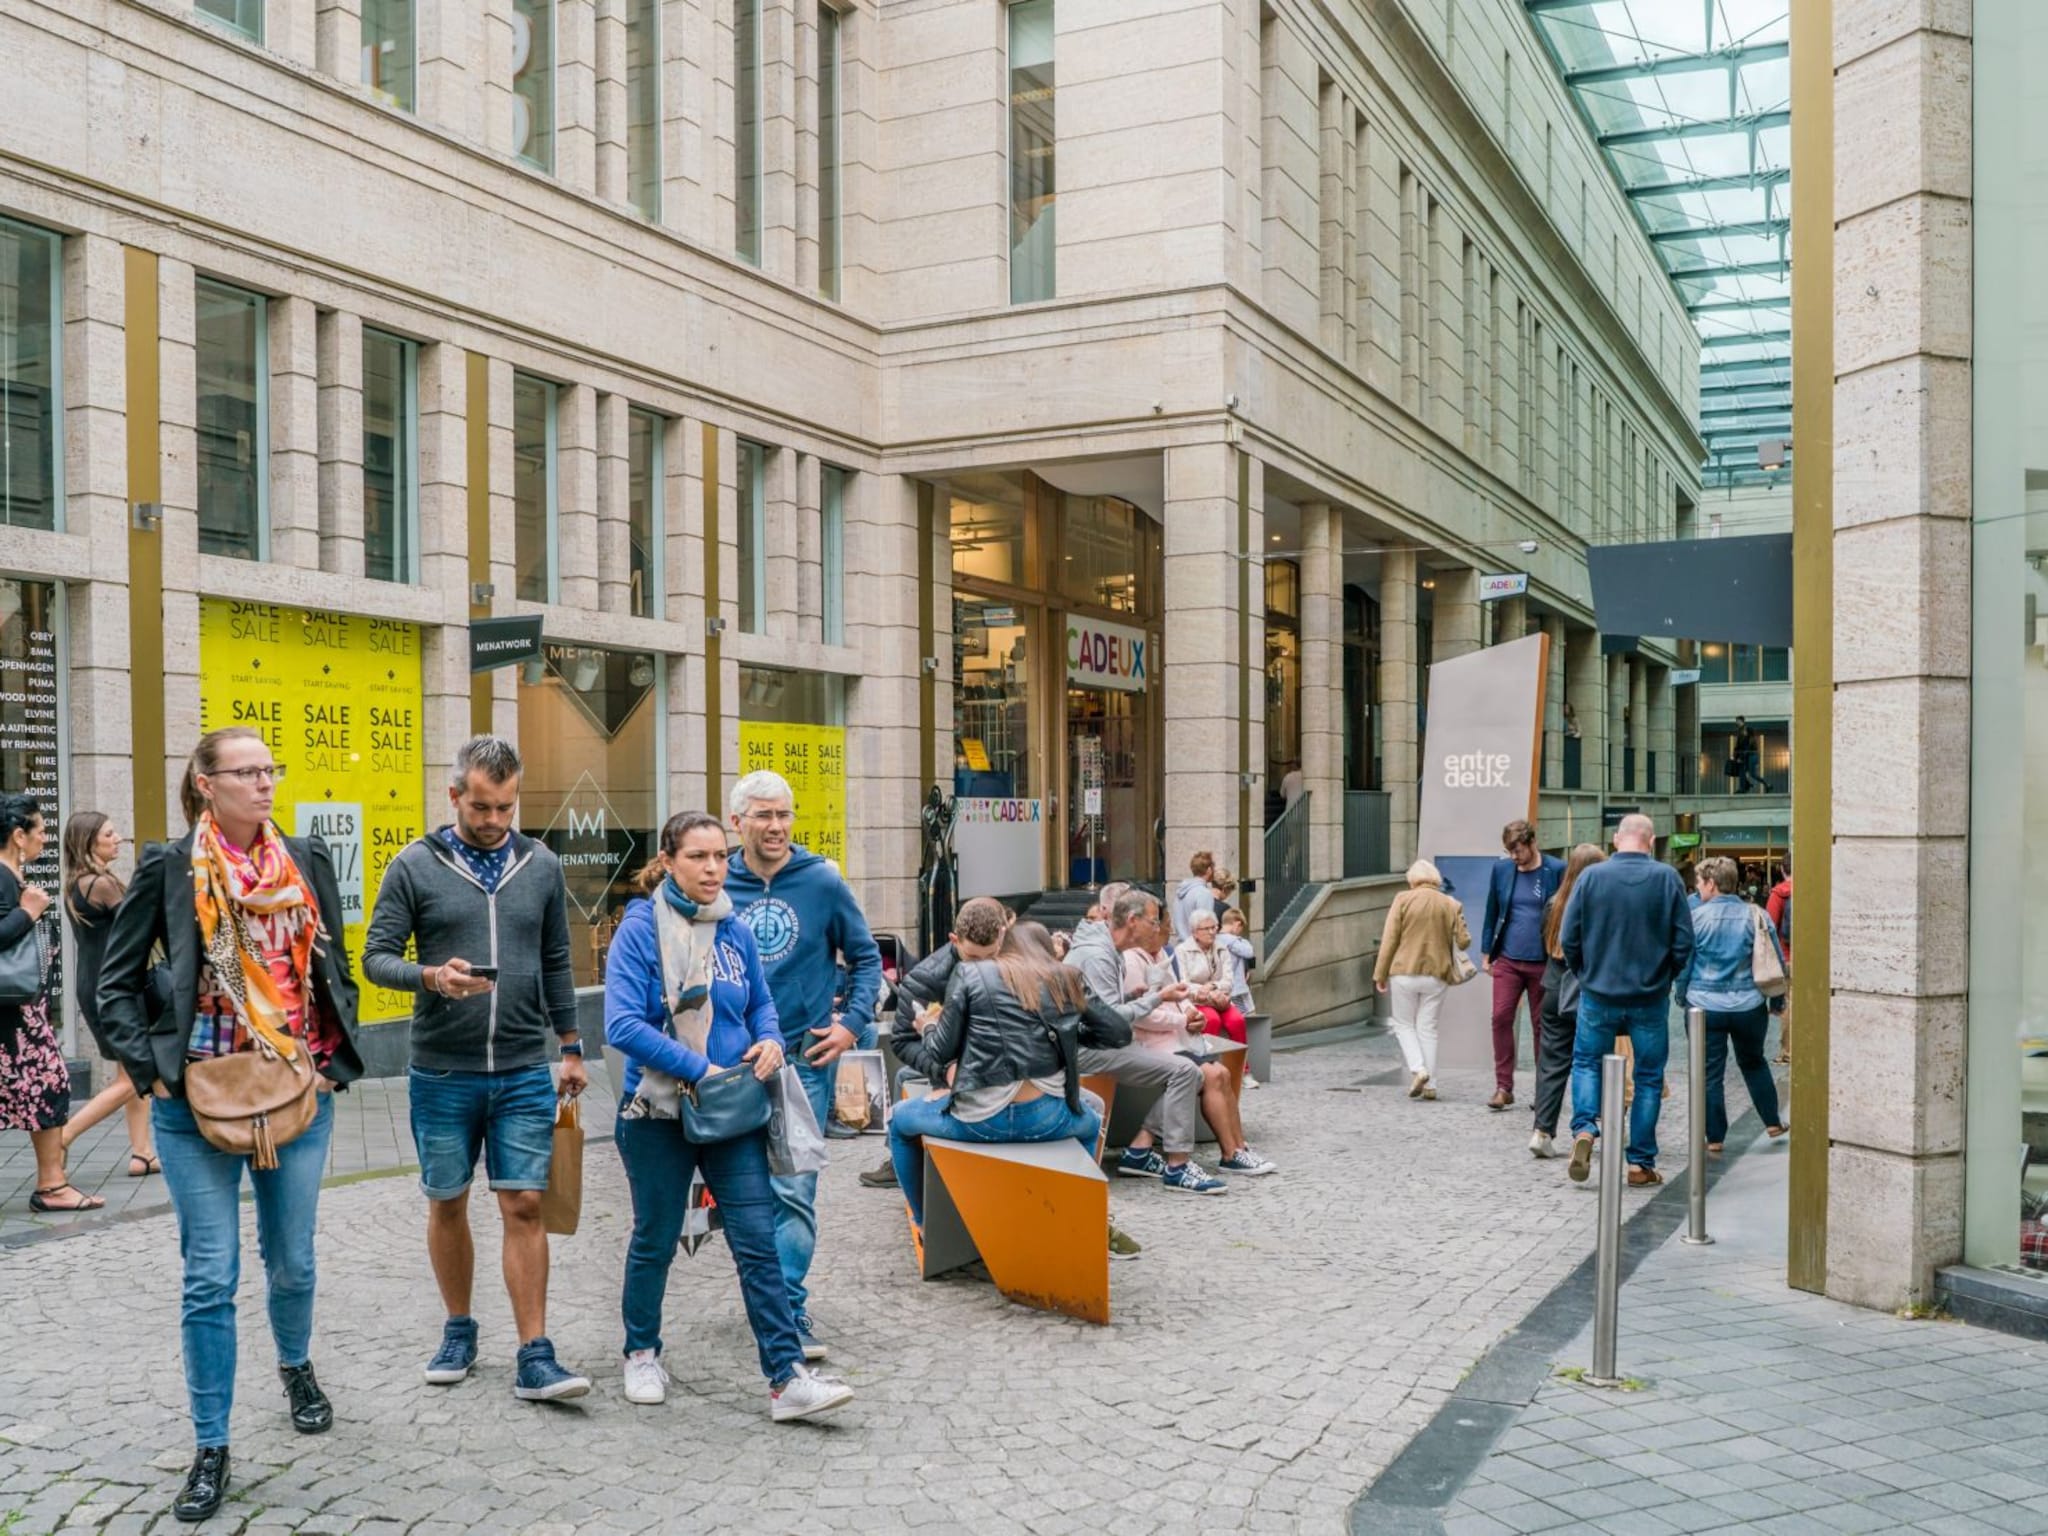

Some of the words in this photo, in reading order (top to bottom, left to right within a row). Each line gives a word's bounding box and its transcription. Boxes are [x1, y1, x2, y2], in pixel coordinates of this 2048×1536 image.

[231, 600, 280, 618] SALE
[30, 632, 54, 642] OBEY
[231, 618, 280, 643] SALE
[303, 625, 349, 649] SALE
[369, 632, 412, 656] SALE
[476, 638, 532, 652] MENATWORK
[1067, 627, 1145, 679] CADEUX
[28, 678, 55, 688] PUMA
[27, 694, 56, 704] WOOD
[24, 709, 56, 719] ELVINE
[233, 700, 282, 722] SALE
[304, 704, 350, 725] SALE
[370, 707, 412, 728] SALE
[7, 723, 56, 735] AUTHENTIC
[1, 740, 13, 749] BY
[14, 740, 56, 750] RIHANNA
[304, 728, 350, 749] SALE
[371, 730, 412, 751] SALE
[748, 741, 774, 757] SALE
[784, 742, 808, 757] SALE
[818, 744, 841, 758] SALE
[35, 756, 57, 766] NIKE
[305, 751, 351, 773] SALE
[371, 753, 413, 774] SALE
[748, 759, 774, 773] SALE
[784, 760, 808, 775] SALE
[1444, 749, 1511, 771] entre
[818, 761, 841, 775] SALE
[31, 771, 57, 781] LEVI'S
[23, 787, 58, 797] ADIDAS
[39, 802, 58, 812] ANS
[992, 800, 1040, 822] CADEUX
[310, 814, 354, 837] ALLES
[372, 827, 415, 846] SALE
[793, 832, 809, 845] ALE
[819, 831, 841, 845] SALE
[25, 864, 59, 874] INDIGO
[340, 895, 362, 911] EER
